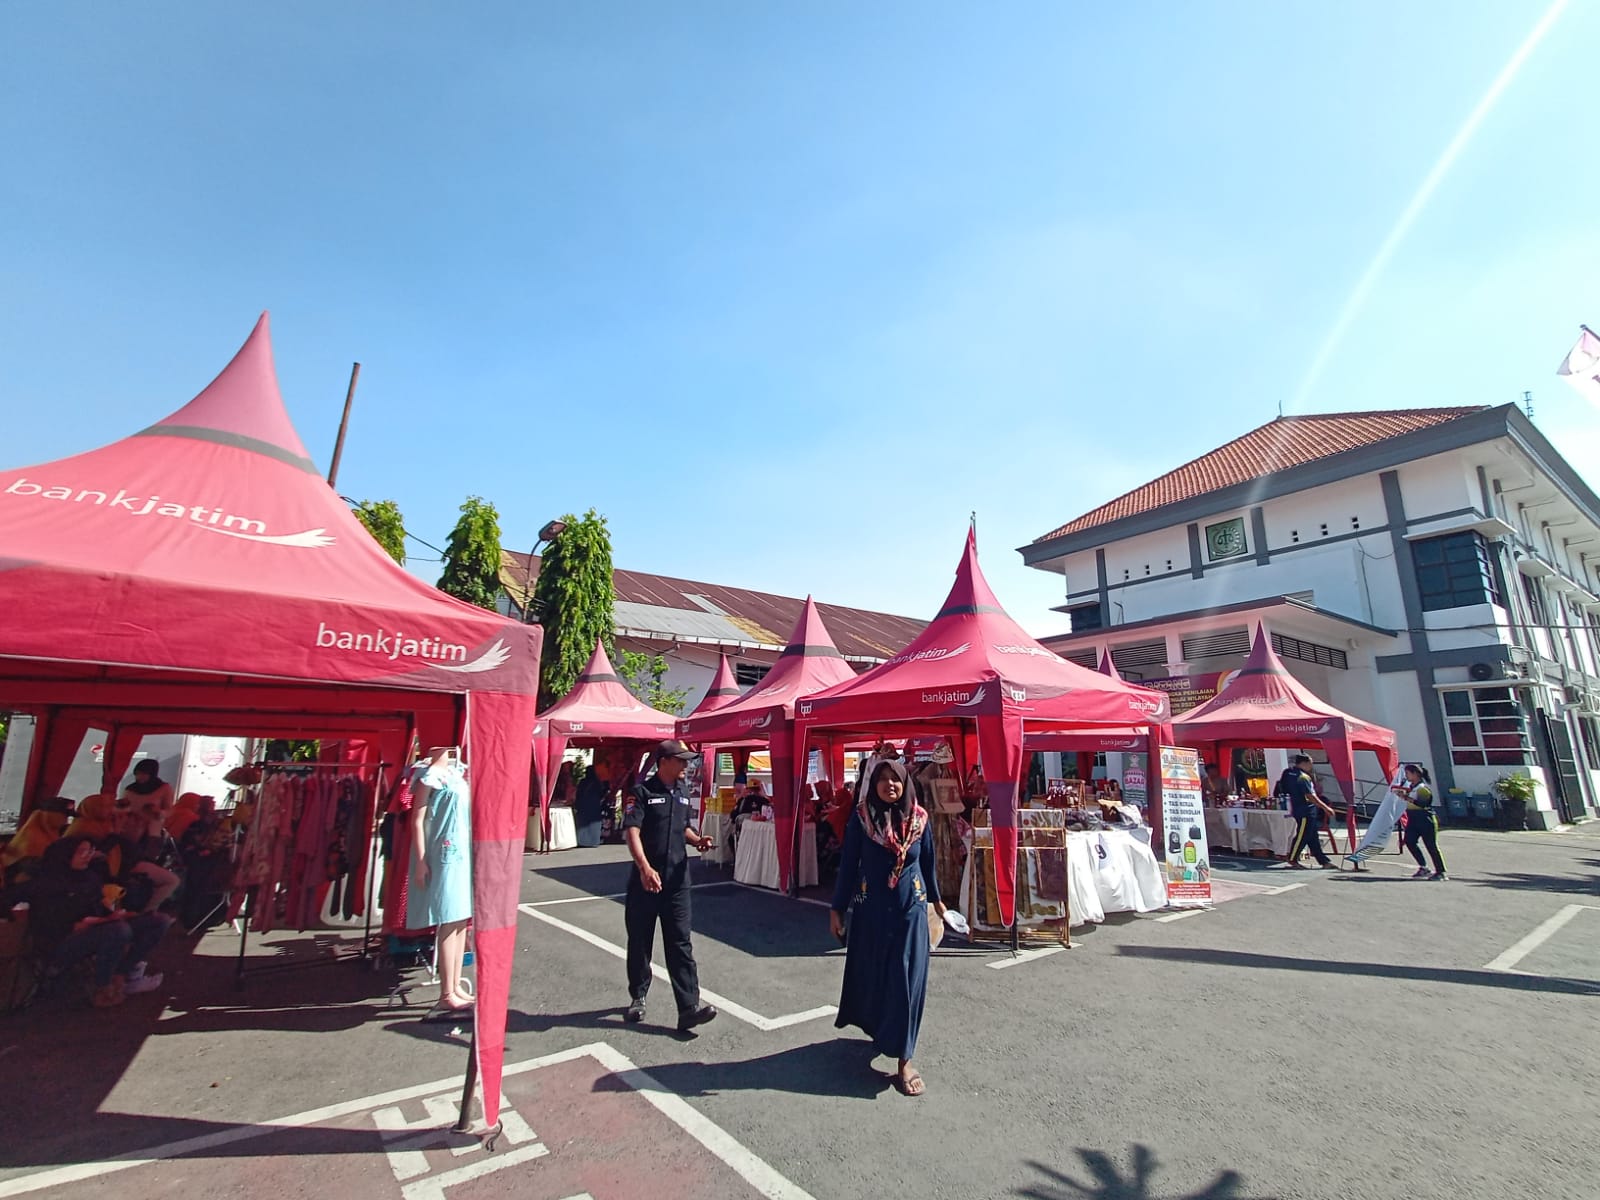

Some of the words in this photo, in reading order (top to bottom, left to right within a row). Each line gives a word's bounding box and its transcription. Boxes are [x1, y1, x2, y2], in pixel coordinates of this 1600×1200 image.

[5, 478, 267, 533] bankjatim
[316, 622, 467, 661] bankjatim
[921, 690, 970, 705] bankjatim
[1275, 723, 1318, 734] bankjatim
[1233, 814, 1238, 824] 1
[1095, 844, 1107, 860] 9
